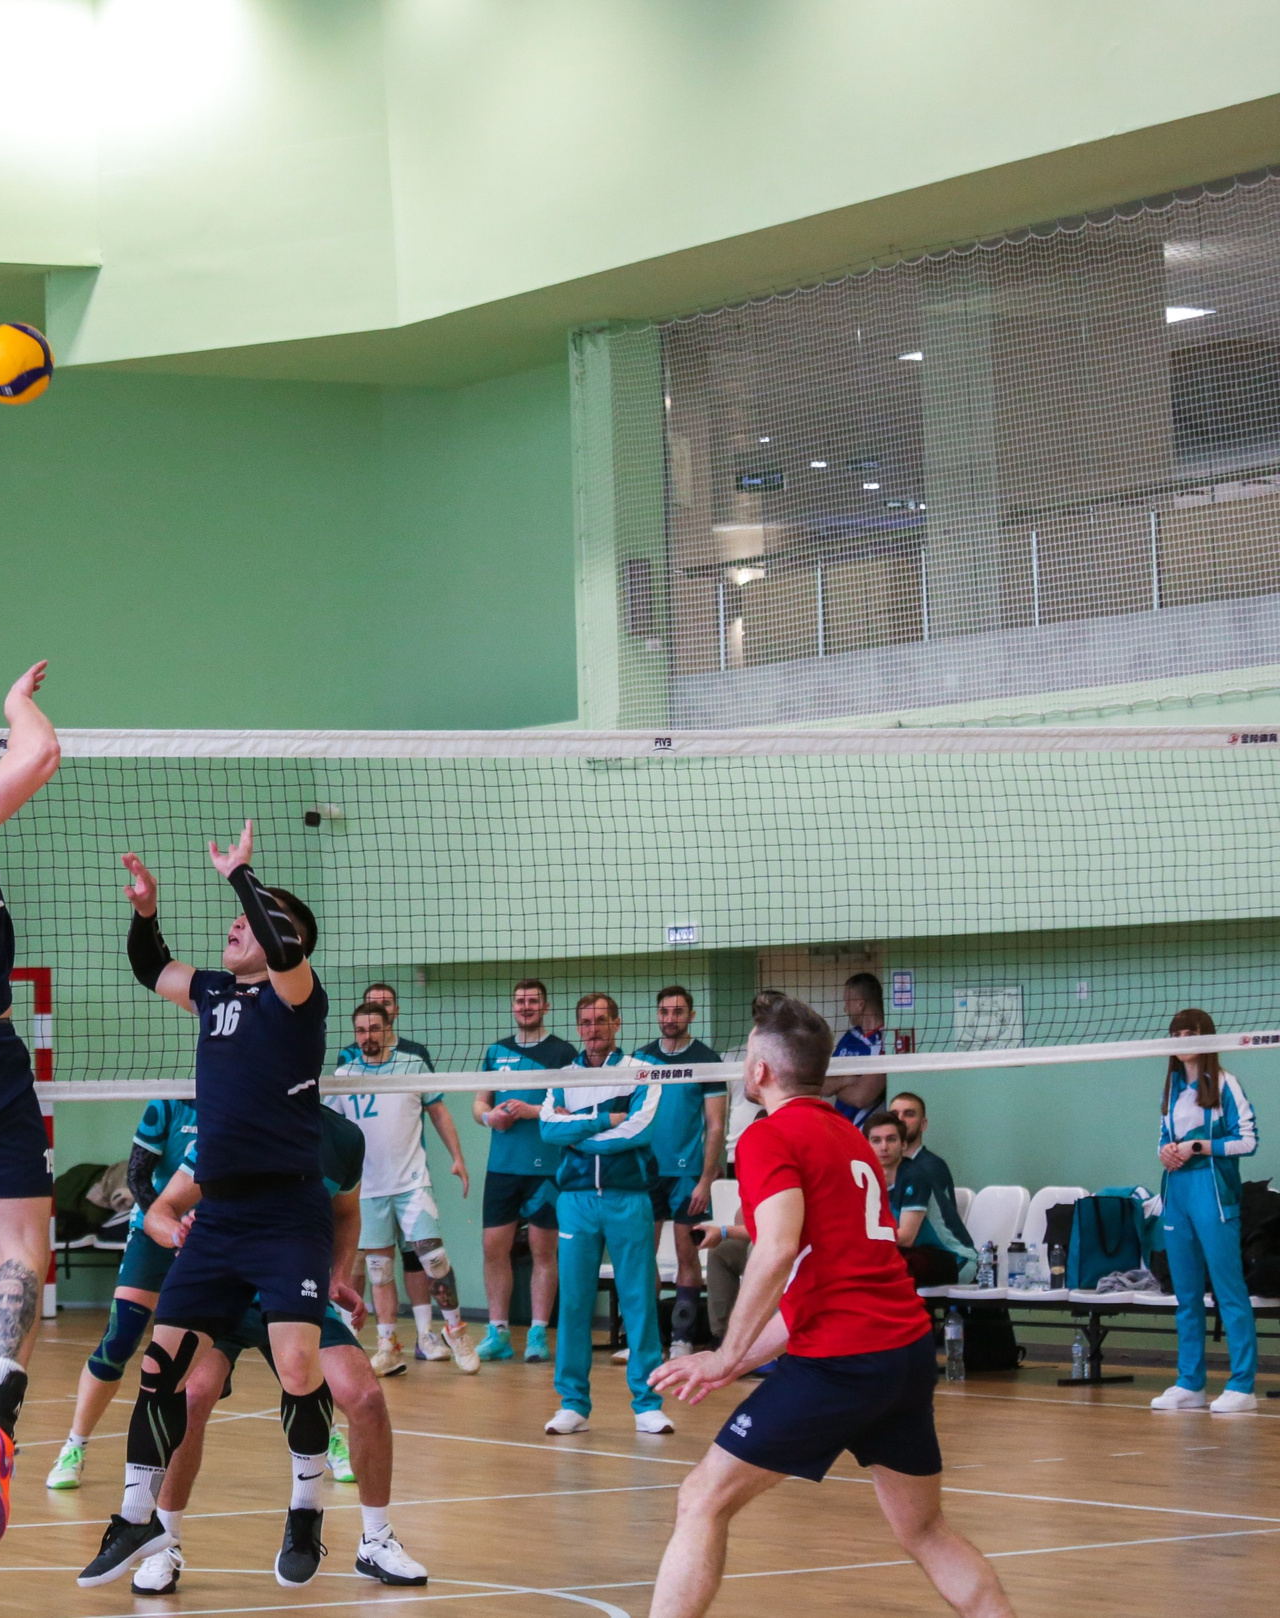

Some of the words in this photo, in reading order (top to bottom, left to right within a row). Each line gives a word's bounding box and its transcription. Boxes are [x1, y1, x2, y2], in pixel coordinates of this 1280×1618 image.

[654, 737, 672, 747] FIVB
[210, 1000, 241, 1036] 16
[348, 1093, 378, 1120] 12
[851, 1160, 896, 1242] 2
